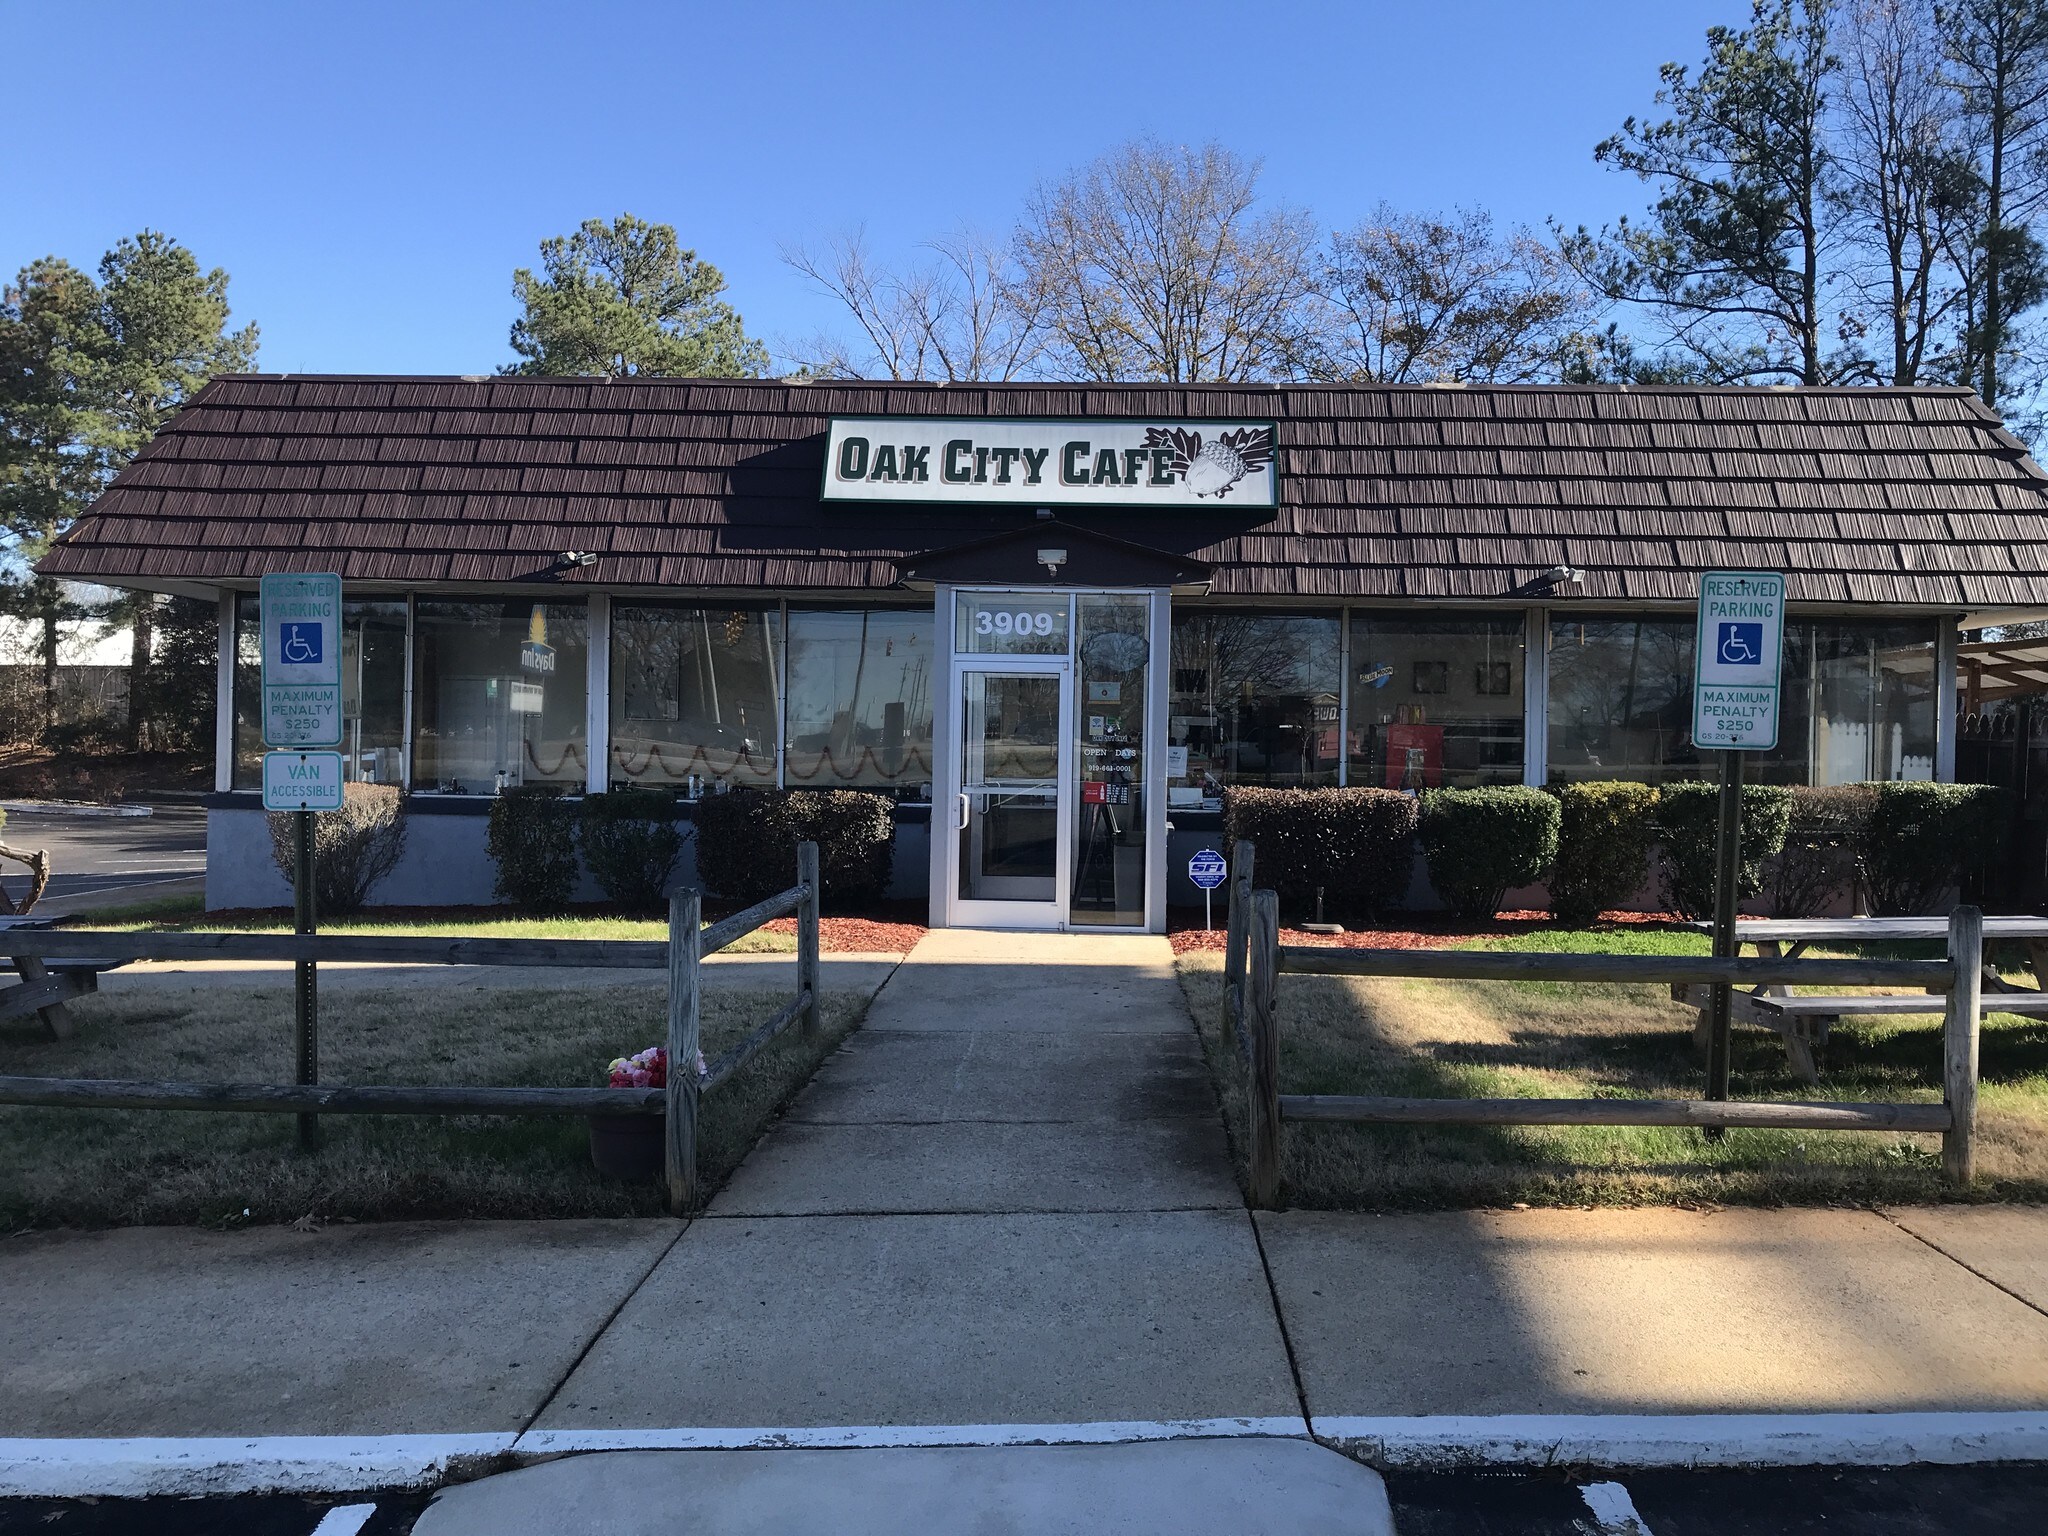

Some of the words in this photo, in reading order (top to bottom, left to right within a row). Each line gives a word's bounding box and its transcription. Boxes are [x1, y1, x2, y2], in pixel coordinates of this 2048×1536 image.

[838, 436, 931, 484] OAK
[941, 439, 1049, 486] CITY
[268, 583, 334, 598] RESERVED
[1707, 581, 1778, 597] RESERVED
[271, 602, 331, 617] PARKING
[1709, 602, 1774, 618] PARKING
[974, 611, 1053, 637] 3909
[1376, 667, 1393, 678] MOON
[271, 691, 333, 702] MAXIMUM
[1703, 691, 1770, 704] MAXIMUM
[271, 705, 333, 716] PENALTY
[1703, 705, 1769, 718] PENALTY
[285, 719, 320, 730] $250
[1716, 719, 1754, 731] $250
[1701, 732, 1712, 740] GS
[1115, 749, 1137, 757] DAYS
[287, 765, 320, 780] VAN
[271, 785, 336, 797] ACCESSIBLE
[1191, 863, 1223, 872] SFI
